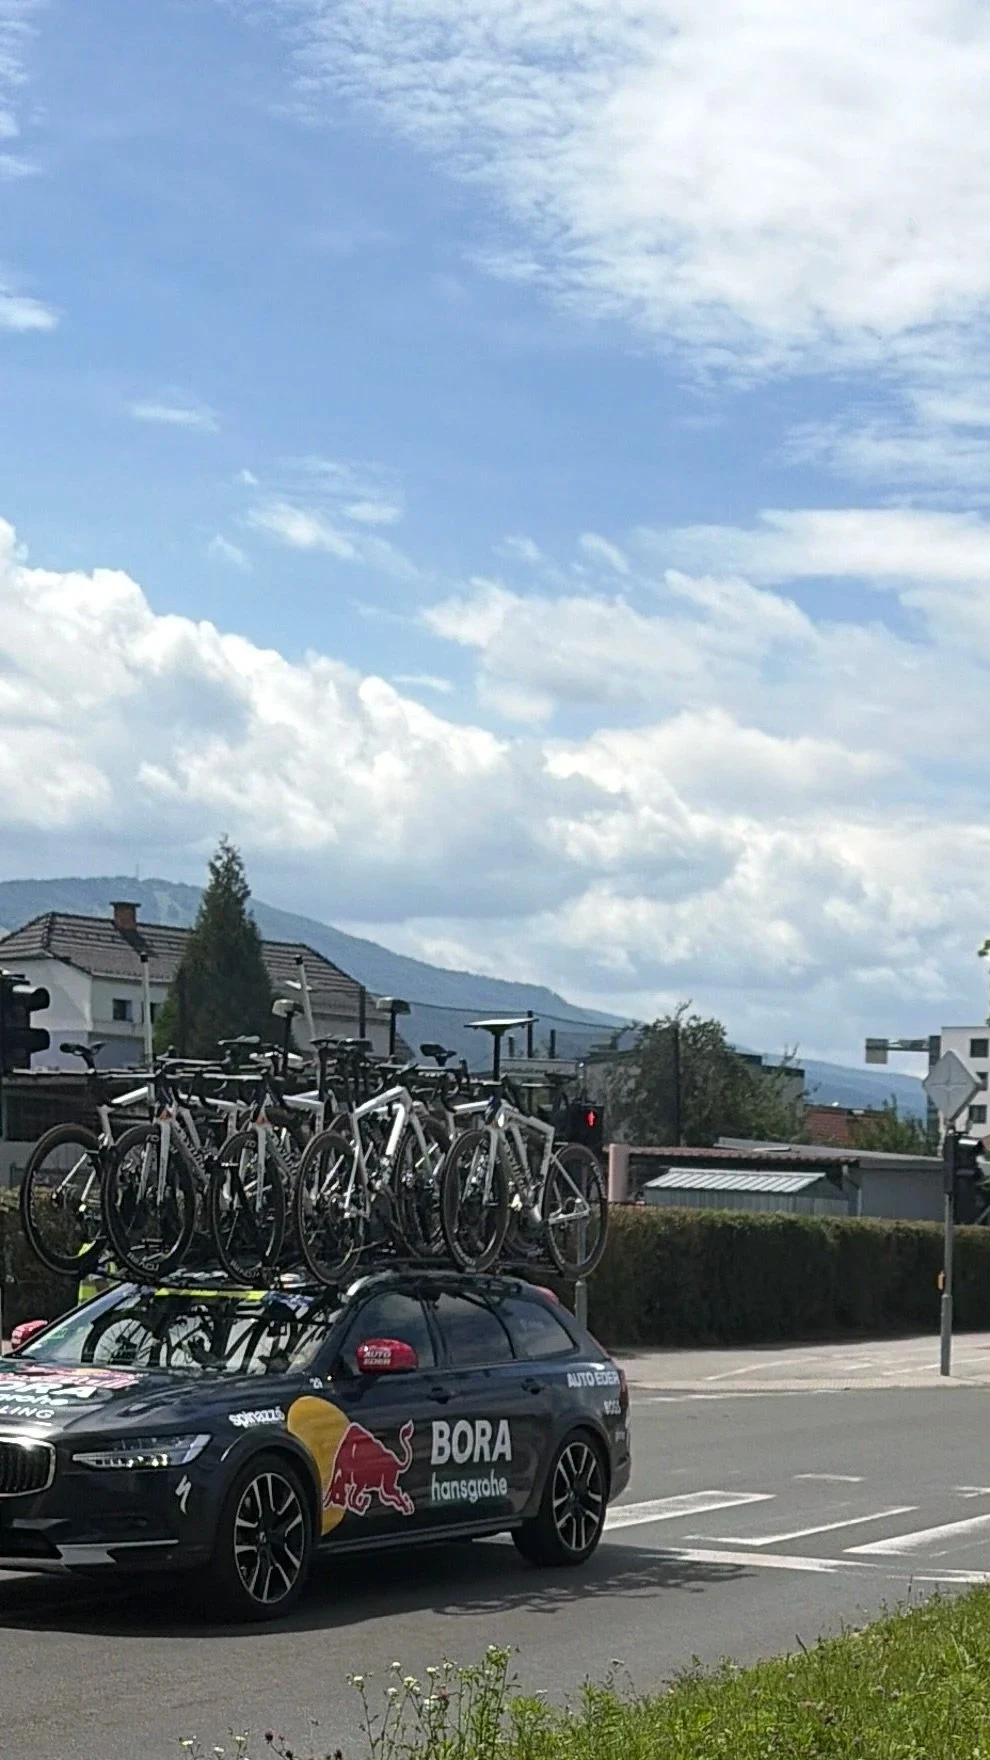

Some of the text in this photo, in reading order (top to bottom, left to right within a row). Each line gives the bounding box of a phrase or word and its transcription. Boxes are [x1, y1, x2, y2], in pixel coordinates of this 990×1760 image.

[567, 1372, 594, 1388] AUTO
[0, 1381, 98, 1398] ORA
[0, 1405, 55, 1419] LING
[430, 1419, 512, 1465] BORA
[431, 1468, 508, 1503] hansgrohe
